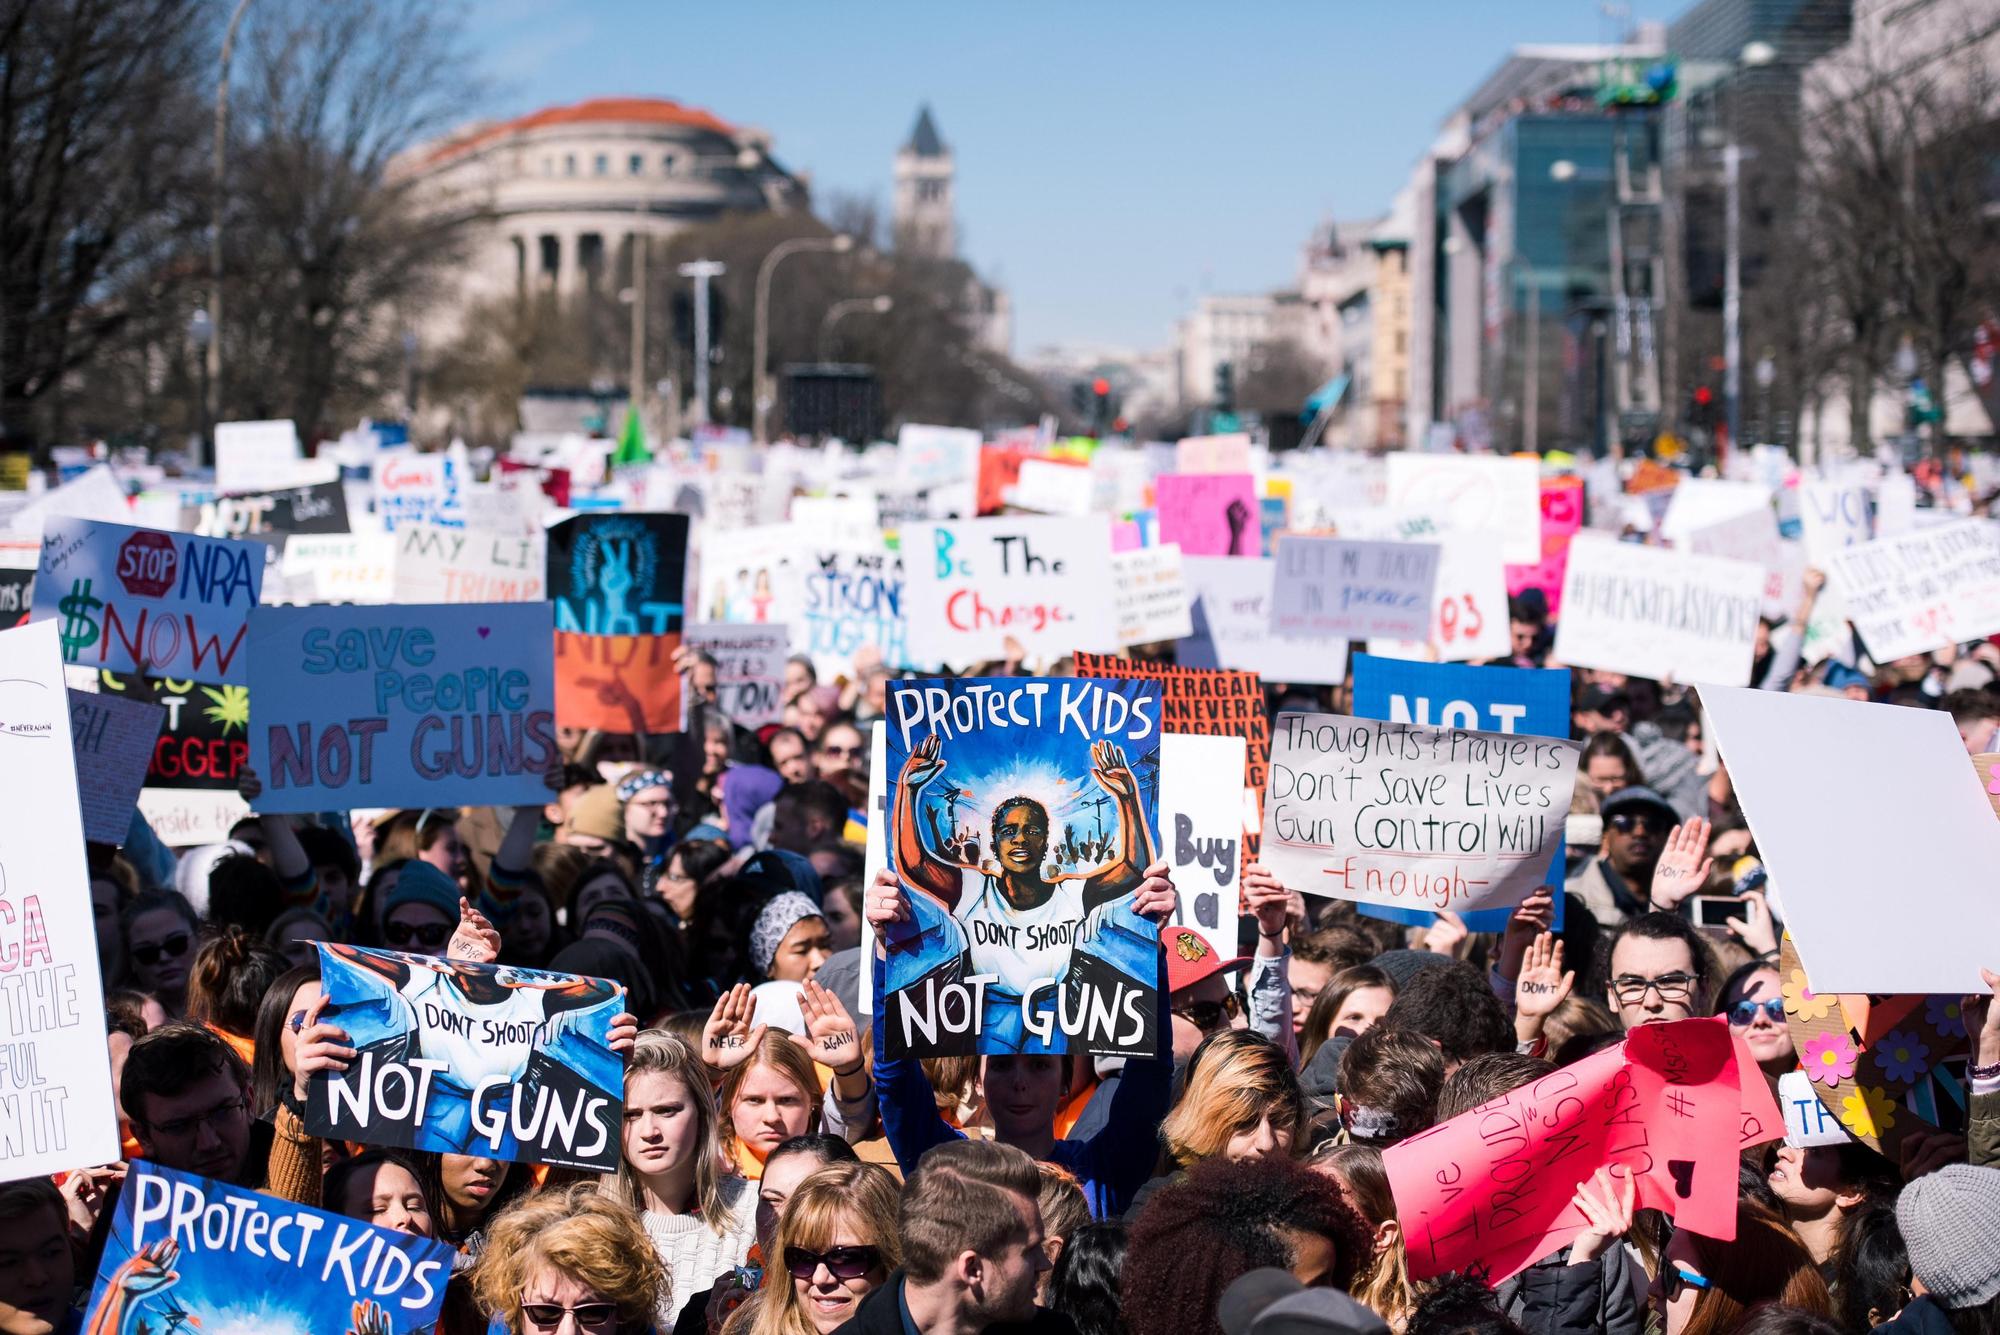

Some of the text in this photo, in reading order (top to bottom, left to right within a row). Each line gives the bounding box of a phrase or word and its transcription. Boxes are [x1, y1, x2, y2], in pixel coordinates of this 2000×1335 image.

[121, 540, 257, 608] STOP NRA
[933, 527, 1067, 580] Be The
[99, 601, 248, 677] NOW
[1059, 682, 1153, 741] KIDS
[268, 709, 559, 790] NOT GUNS
[1282, 716, 1424, 765] Thoughts
[1450, 732, 1563, 779] Prayers
[1273, 764, 1551, 808] Don't Save Lives
[1175, 813, 1236, 887] Buy
[1275, 804, 1545, 853] Gun Control Will
[974, 919, 1077, 950] DONT SHOOT
[1, 963, 80, 1037] THE
[425, 1003, 538, 1047] DONT SHOOT
[899, 974, 1145, 1048] NOT GUNS
[709, 1036, 746, 1050] NEVER
[822, 1031, 855, 1052] AGAIN
[328, 1052, 609, 1158] NOT GUNS
[1603, 1069, 1654, 1179] CLASS
[321, 1222, 442, 1310] KIDS
